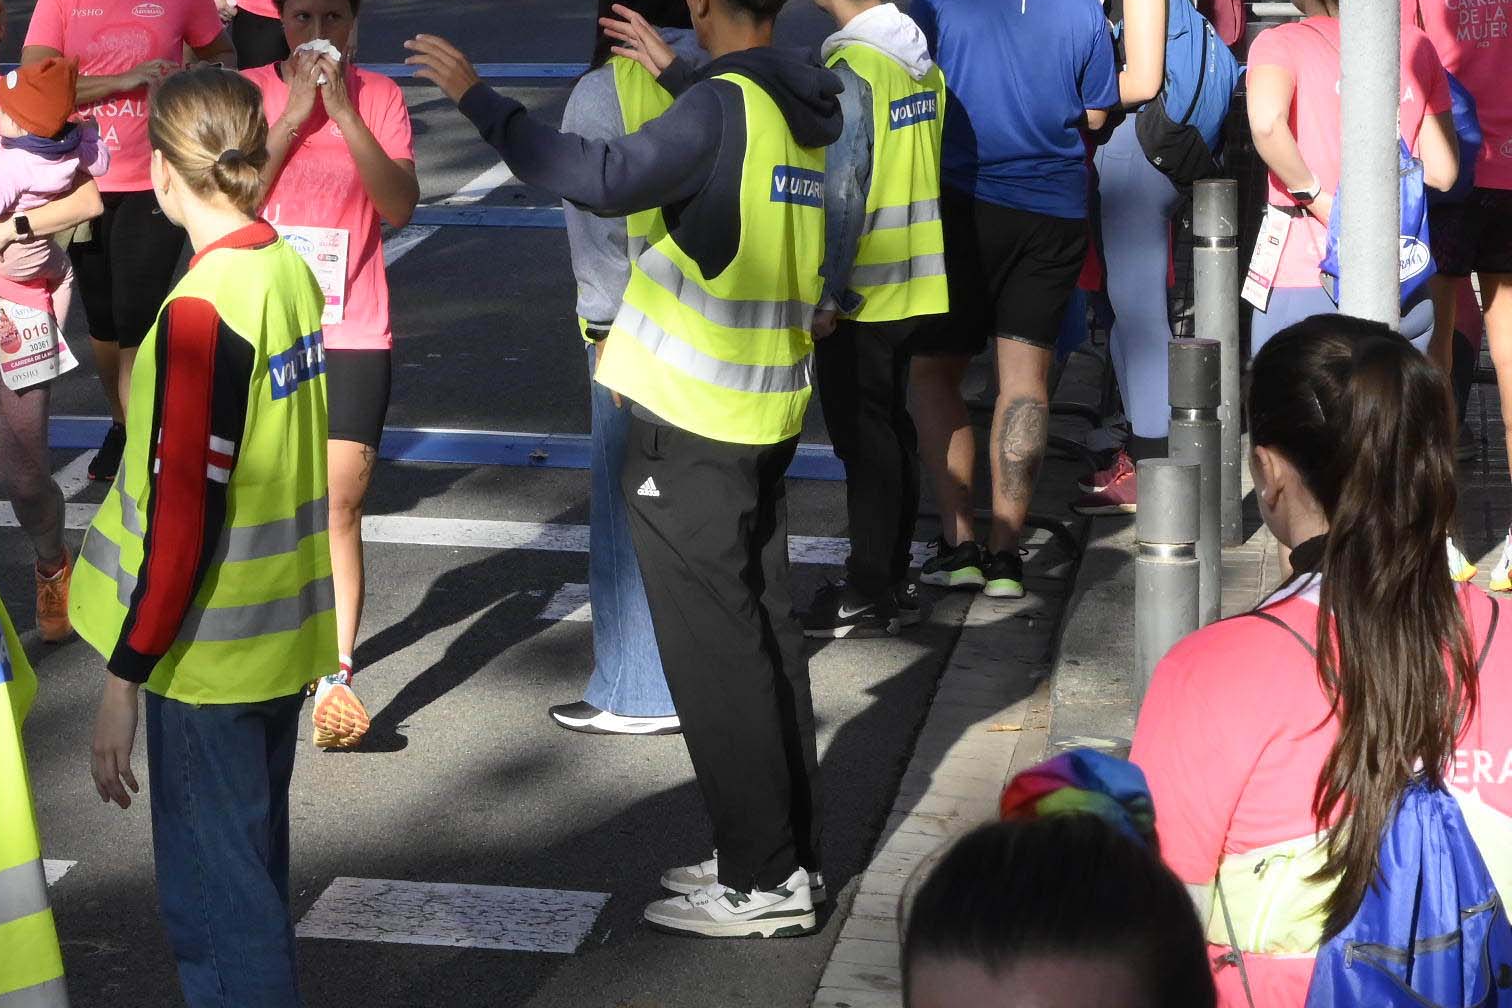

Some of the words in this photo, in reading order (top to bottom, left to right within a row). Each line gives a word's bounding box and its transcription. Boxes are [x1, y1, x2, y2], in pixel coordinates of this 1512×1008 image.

[1460, 8, 1480, 25] DE
[1485, 6, 1506, 21] LA
[1456, 22, 1508, 42] MUJER
[23, 323, 48, 340] 016
